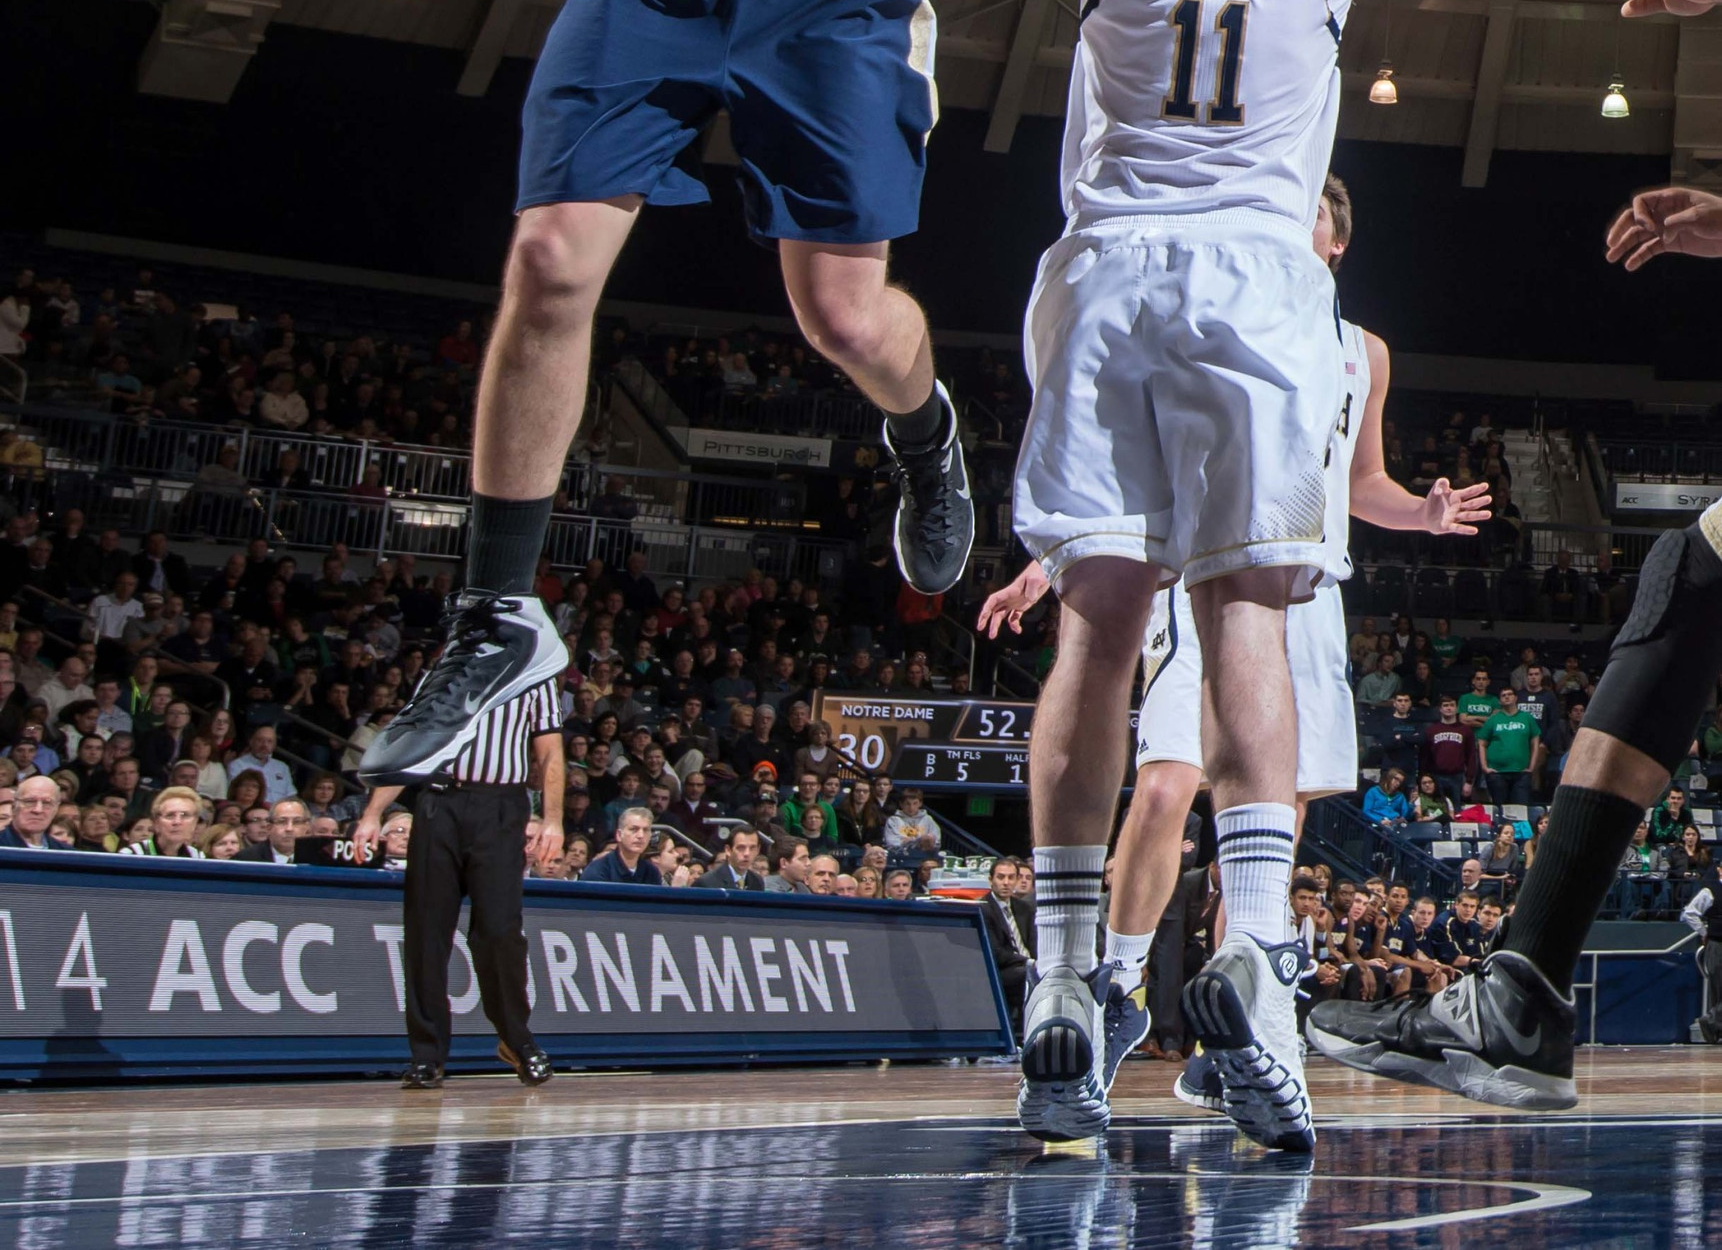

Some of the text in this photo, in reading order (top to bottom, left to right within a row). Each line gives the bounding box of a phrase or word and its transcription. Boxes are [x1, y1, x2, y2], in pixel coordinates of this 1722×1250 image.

[703, 440, 821, 461] PITTSBURGH
[841, 705, 934, 720] NOTRE DAME
[838, 734, 885, 769] 30
[926, 753, 936, 764] B
[947, 750, 981, 760] TM FLS
[925, 767, 935, 777] P
[957, 762, 969, 781] 5
[1010, 764, 1023, 783] 1
[332, 840, 374, 861] POS
[148, 919, 338, 1013] ACC
